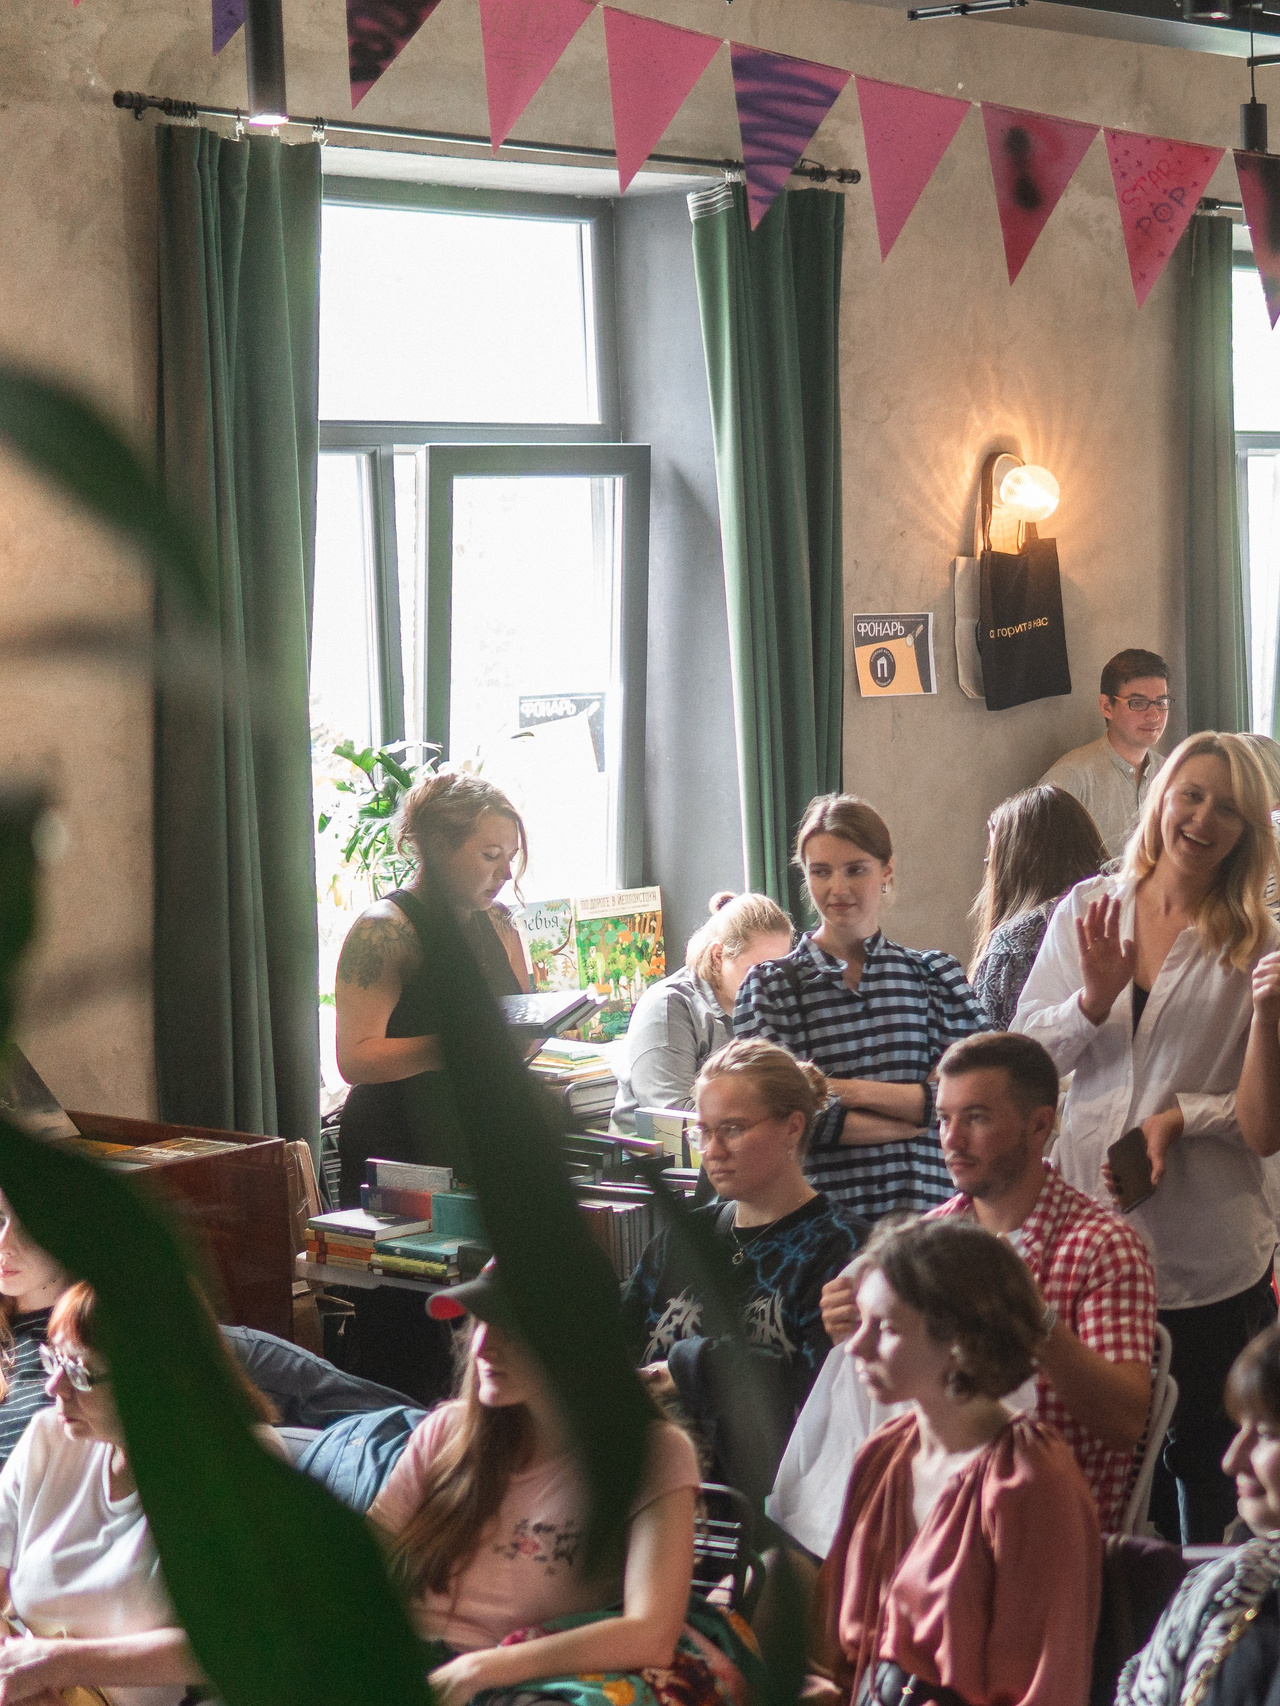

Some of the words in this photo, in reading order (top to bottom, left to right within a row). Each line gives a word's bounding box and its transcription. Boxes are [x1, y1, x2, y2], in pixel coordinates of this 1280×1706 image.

[1121, 159, 1183, 205] STAR
[1135, 186, 1185, 239] POP
[857, 621, 905, 637] ФОНАРЬ
[997, 623, 1028, 640] горит
[1033, 616, 1049, 628] нас
